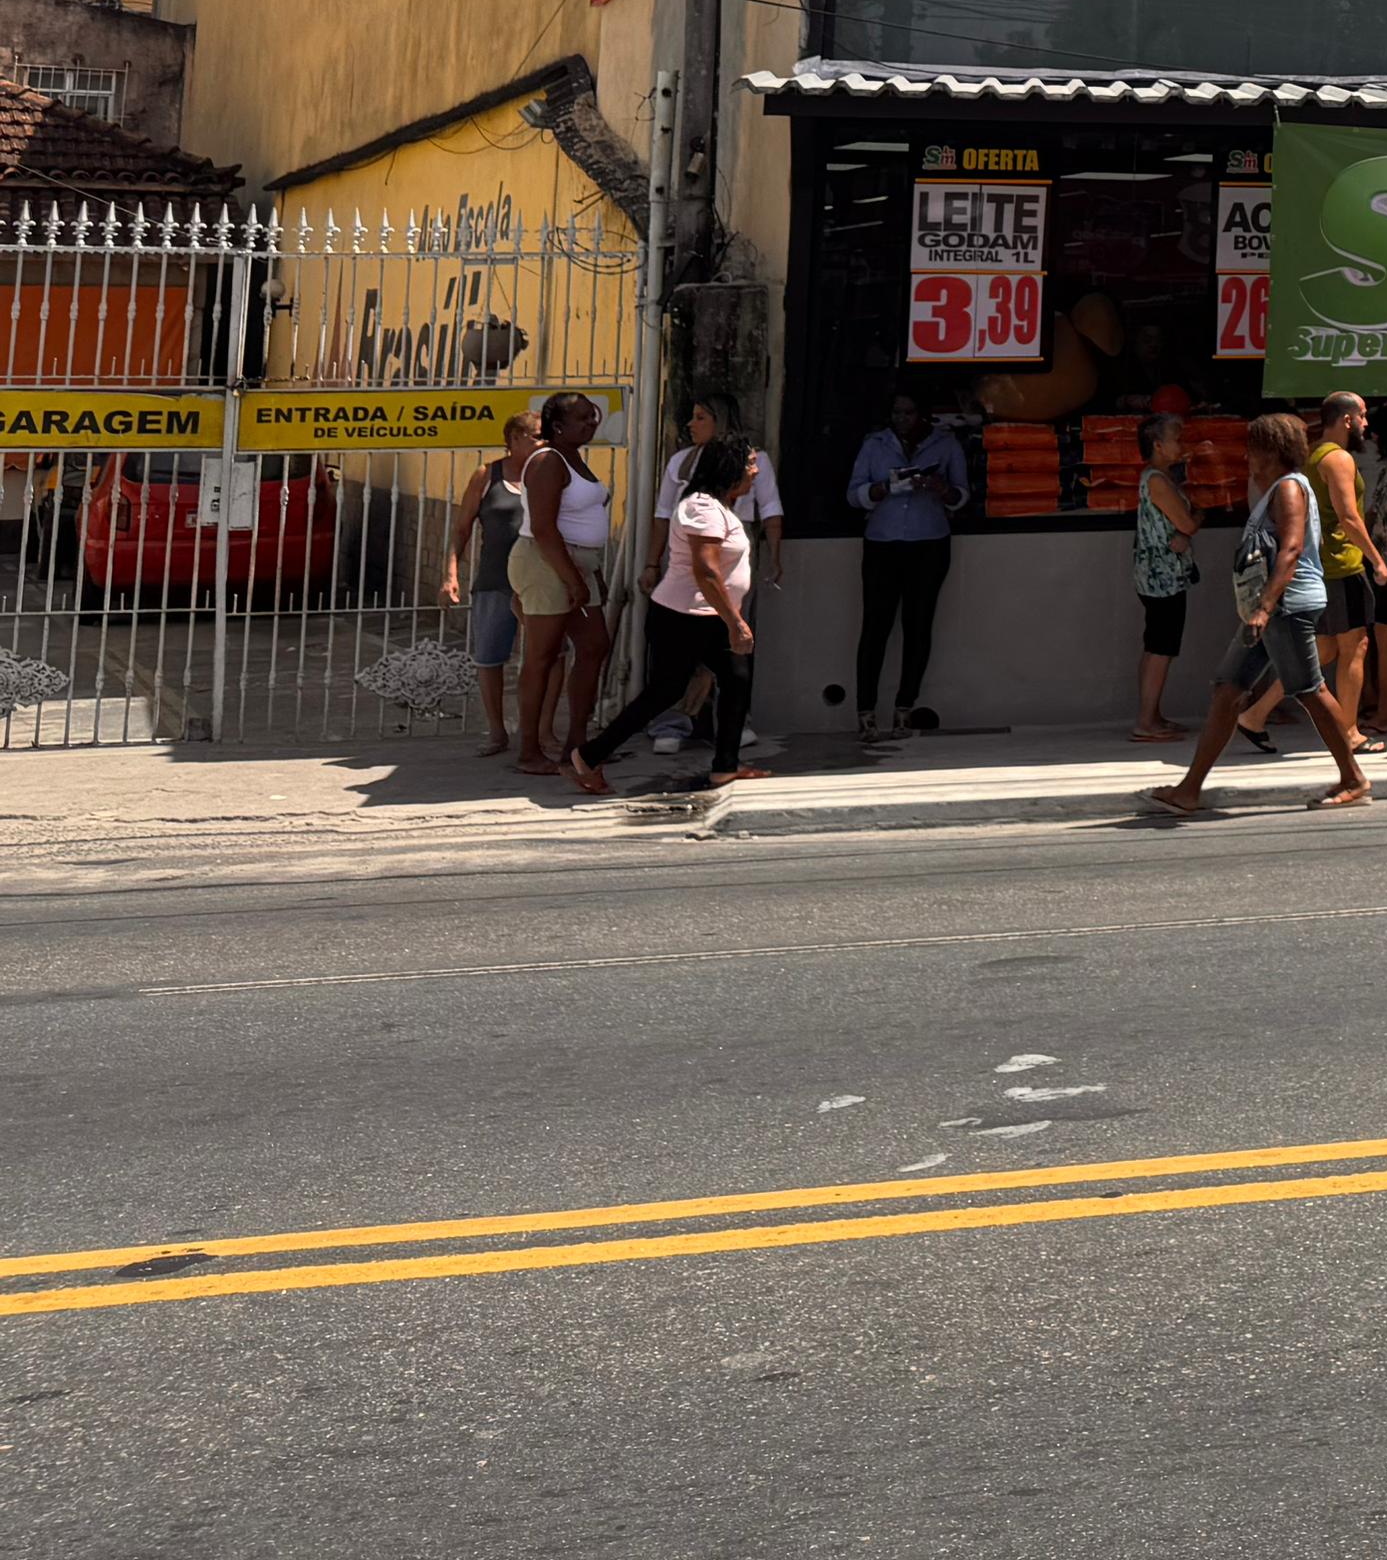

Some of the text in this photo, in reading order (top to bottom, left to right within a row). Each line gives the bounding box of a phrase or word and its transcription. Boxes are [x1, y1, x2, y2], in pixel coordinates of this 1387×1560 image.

[963, 148, 1040, 171] OFERTA
[917, 191, 1040, 235] LEITE
[917, 232, 1039, 251] GODAM
[928, 249, 1036, 264] INTEGRAL 1L
[912, 275, 1040, 353] 3,39
[256, 400, 496, 424] ENTRADA / SAÍDA
[313, 424, 439, 439] DE VEÍCULOS
